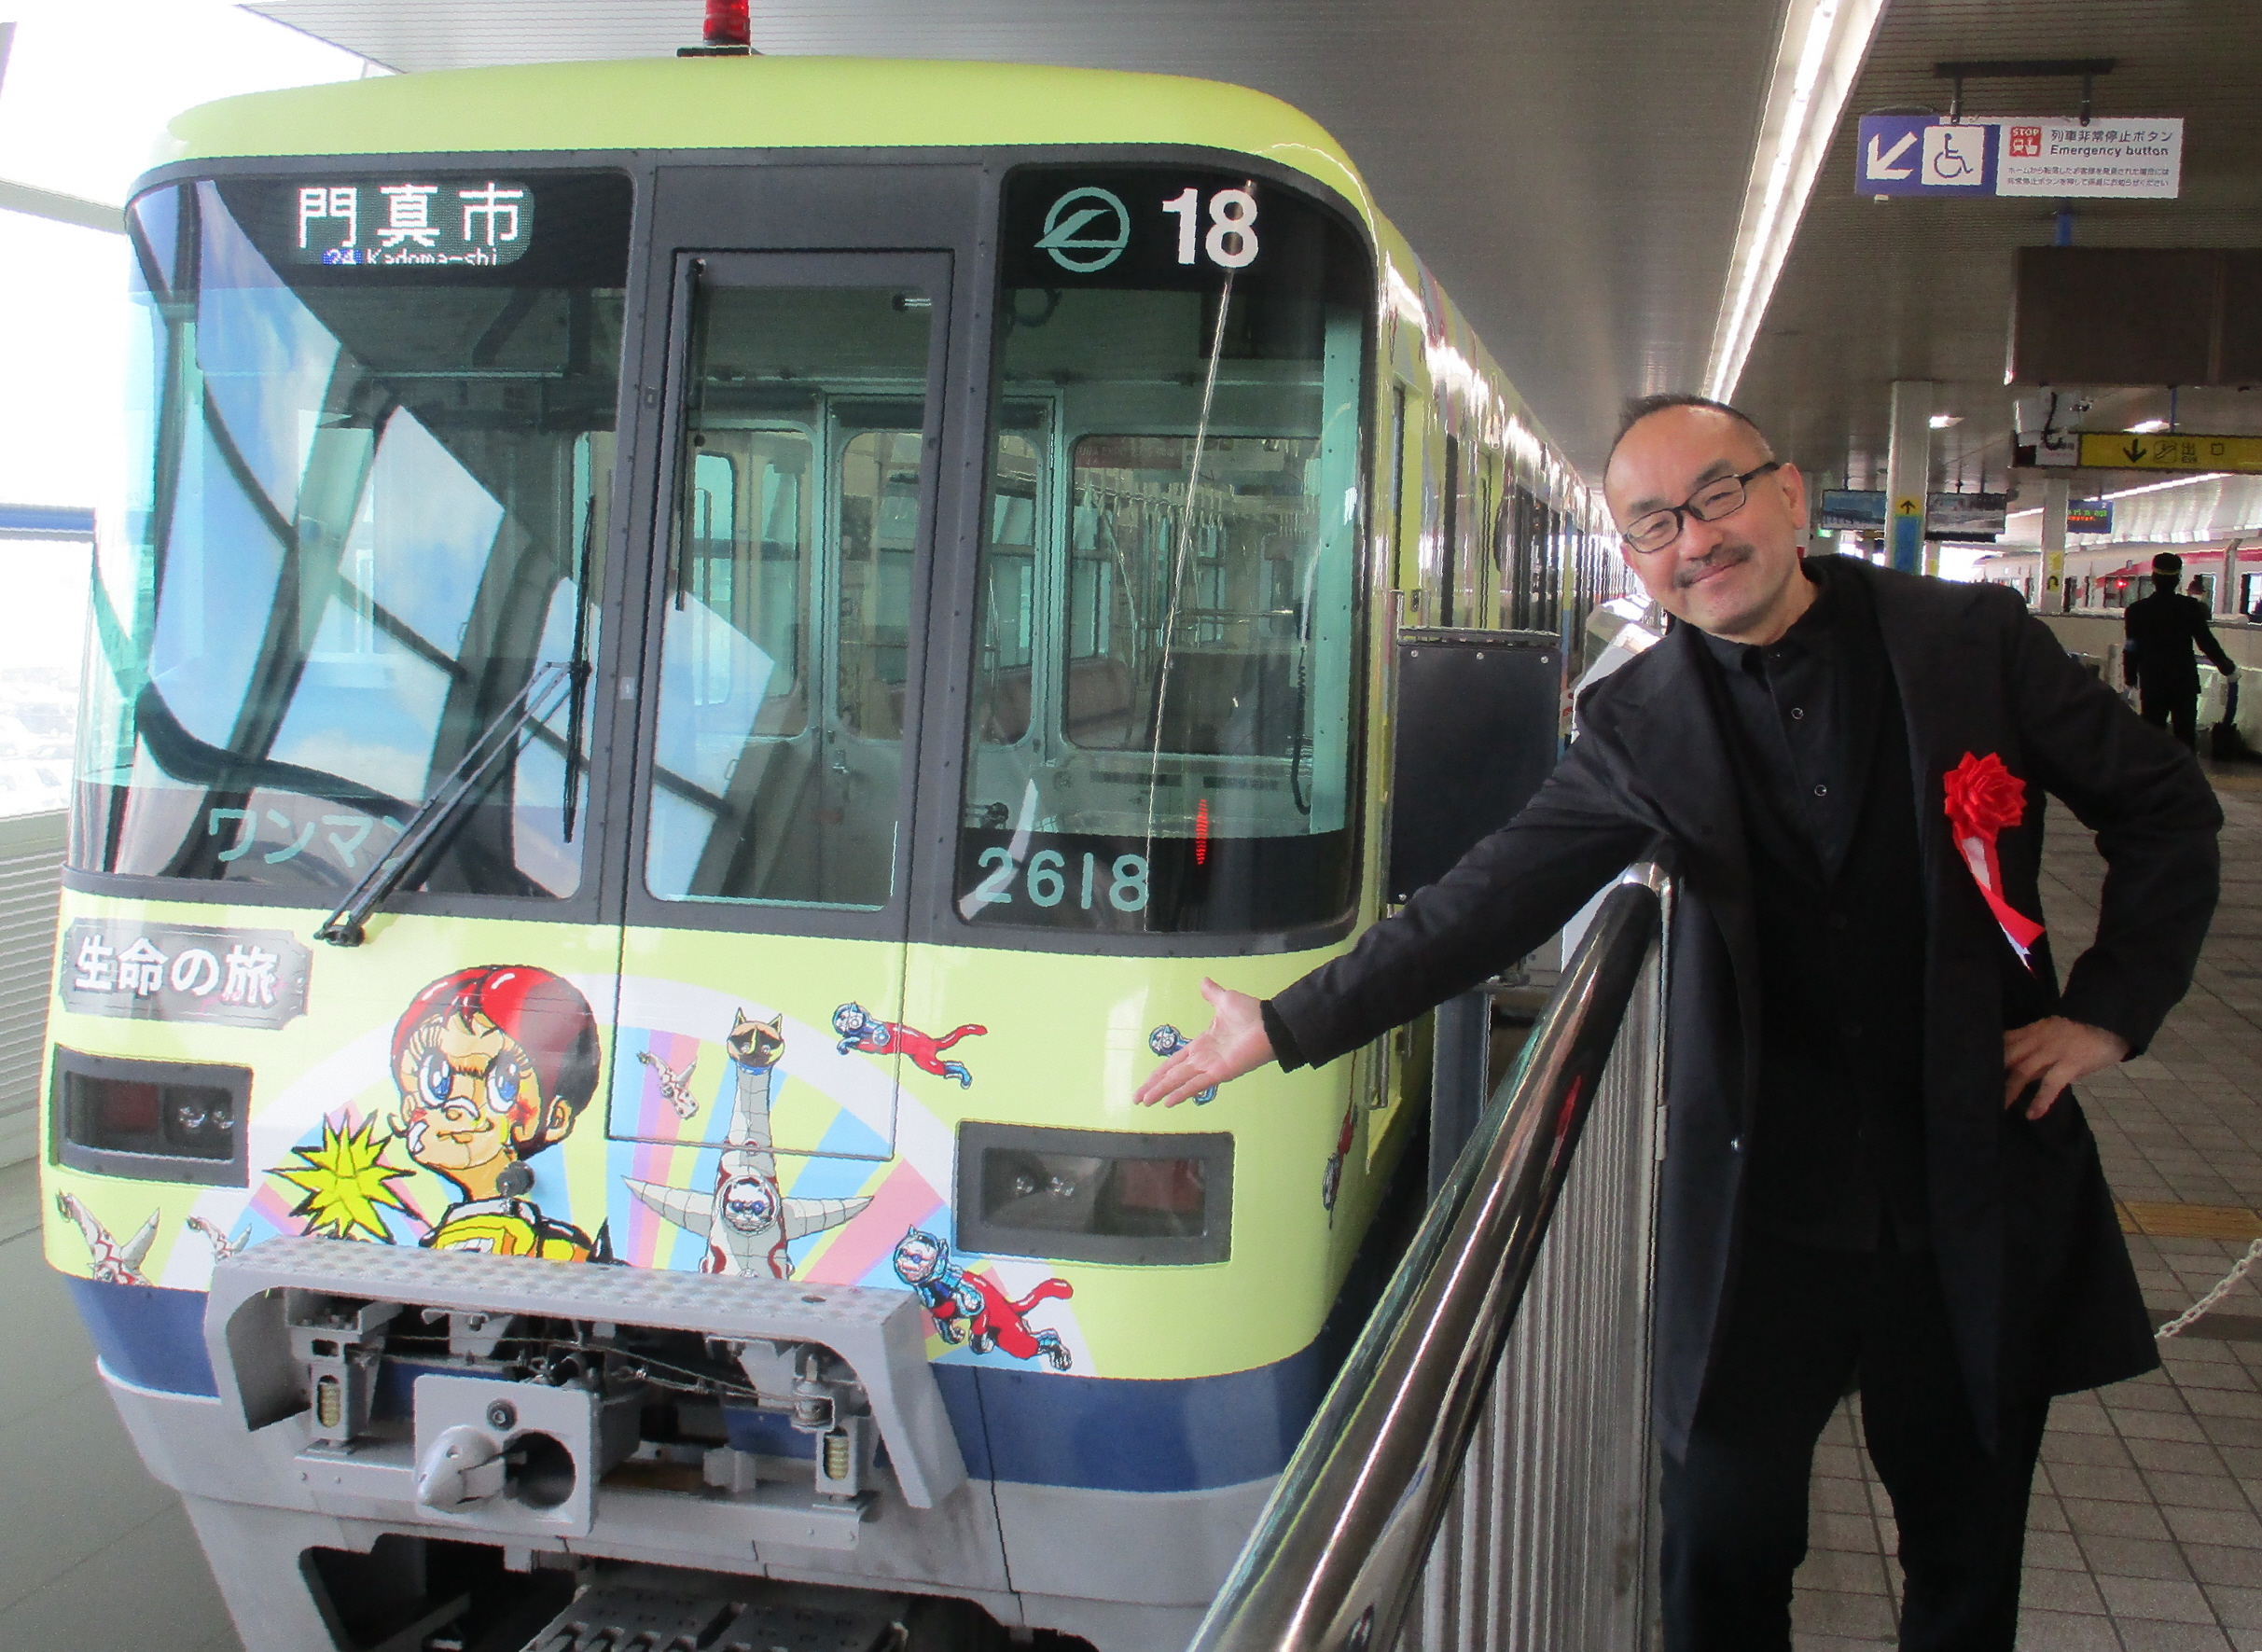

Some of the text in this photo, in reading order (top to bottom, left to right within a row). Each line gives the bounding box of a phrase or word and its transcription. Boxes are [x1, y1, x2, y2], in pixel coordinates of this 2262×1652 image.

[2011, 127, 2040, 136] STOP
[2050, 130, 2173, 144] 列車非常停止ボタン
[2050, 145, 2169, 158] Emergency button
[298, 181, 525, 249] 門真市
[1162, 187, 1259, 269] 18
[975, 846, 1150, 912] 2618
[75, 934, 281, 1006] 生命の旅
